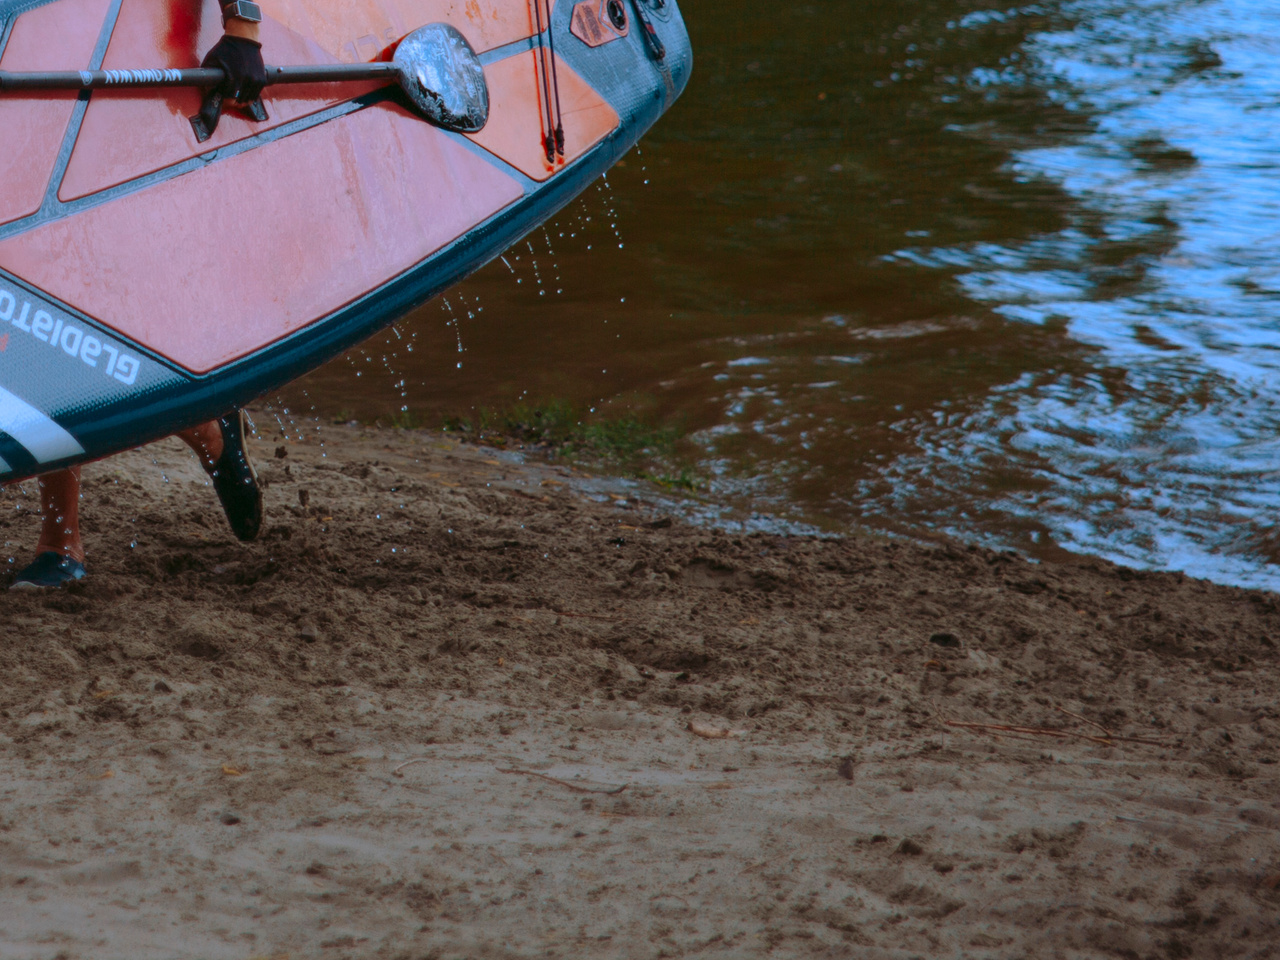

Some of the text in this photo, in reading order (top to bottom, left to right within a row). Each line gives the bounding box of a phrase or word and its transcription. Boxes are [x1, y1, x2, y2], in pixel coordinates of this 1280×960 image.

[103, 68, 182, 83] MY OWN WAY
